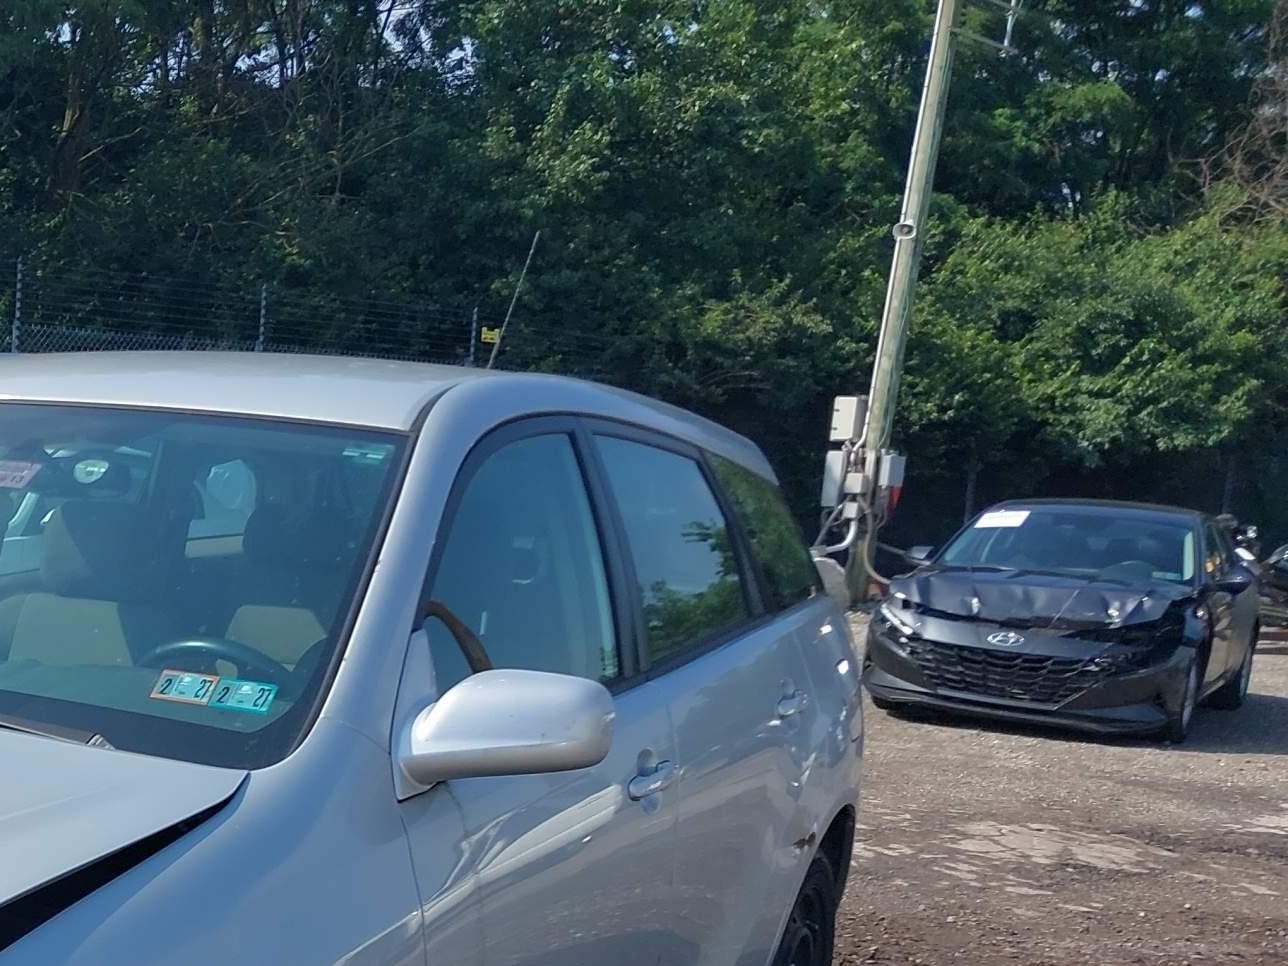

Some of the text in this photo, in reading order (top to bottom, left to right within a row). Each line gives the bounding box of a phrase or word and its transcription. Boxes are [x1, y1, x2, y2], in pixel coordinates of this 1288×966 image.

[159, 678, 213, 700] 2 27
[216, 686, 272, 709] 2 27
